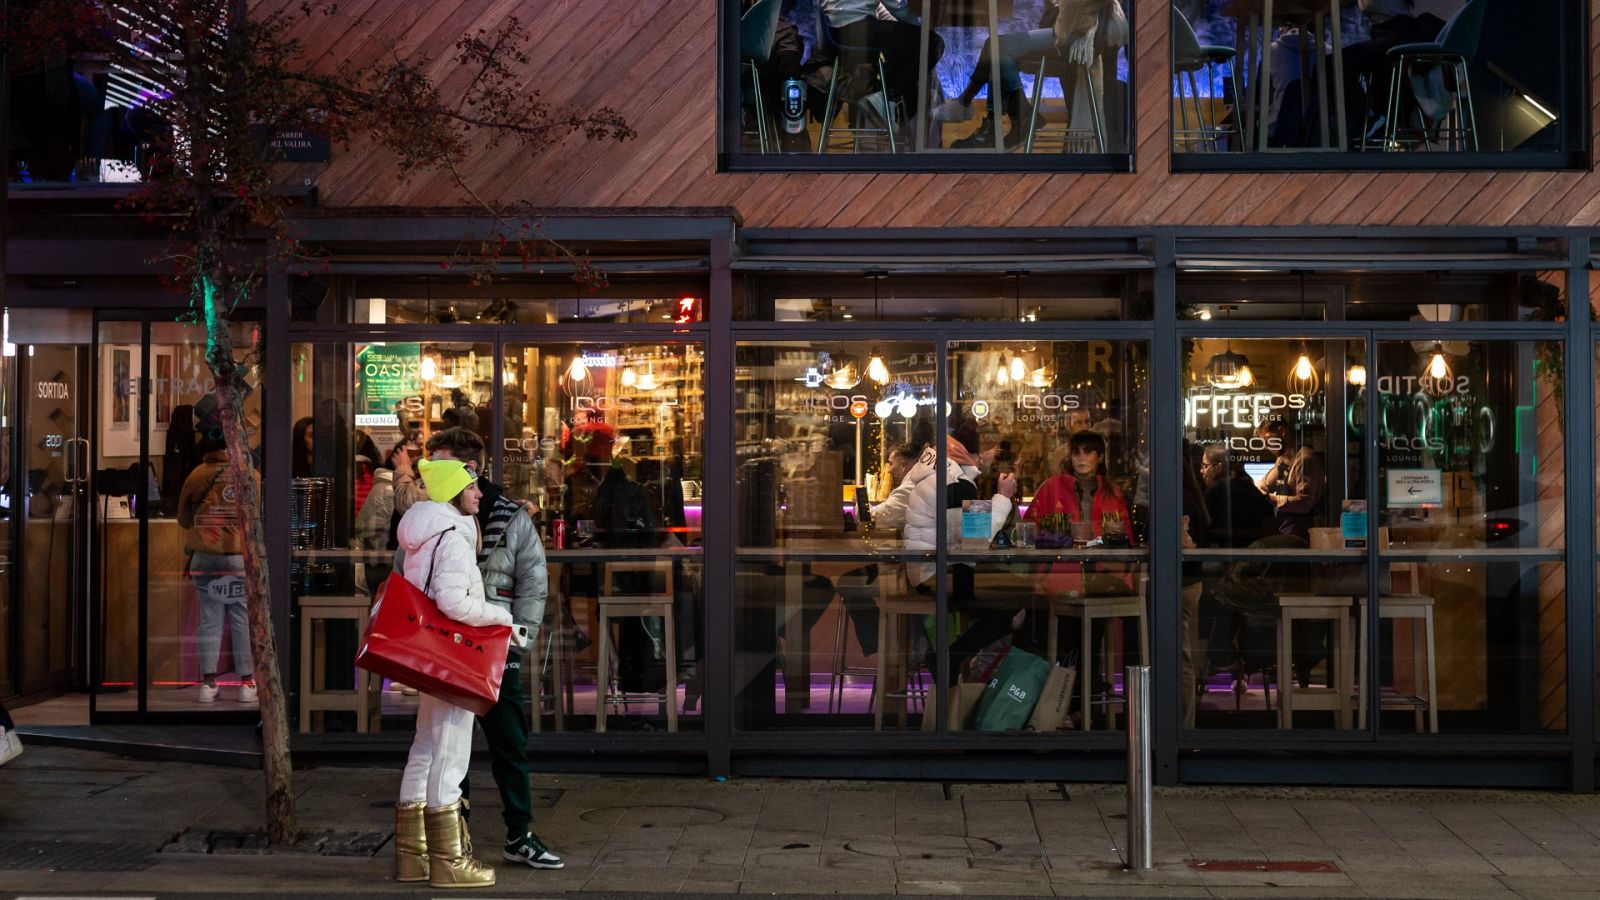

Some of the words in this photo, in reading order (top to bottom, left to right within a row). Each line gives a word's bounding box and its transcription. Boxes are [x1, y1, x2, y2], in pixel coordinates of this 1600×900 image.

[283, 141, 312, 149] VALIRA
[365, 363, 418, 377] OASIS
[38, 382, 69, 399] SORTIDA
[570, 396, 633, 413] IQOS
[1016, 394, 1080, 411] IQOS
[503, 437, 556, 452] QOS
[1225, 437, 1283, 452] IQOS
[1387, 437, 1445, 452] IQOS
[1009, 684, 1026, 699] P&B
